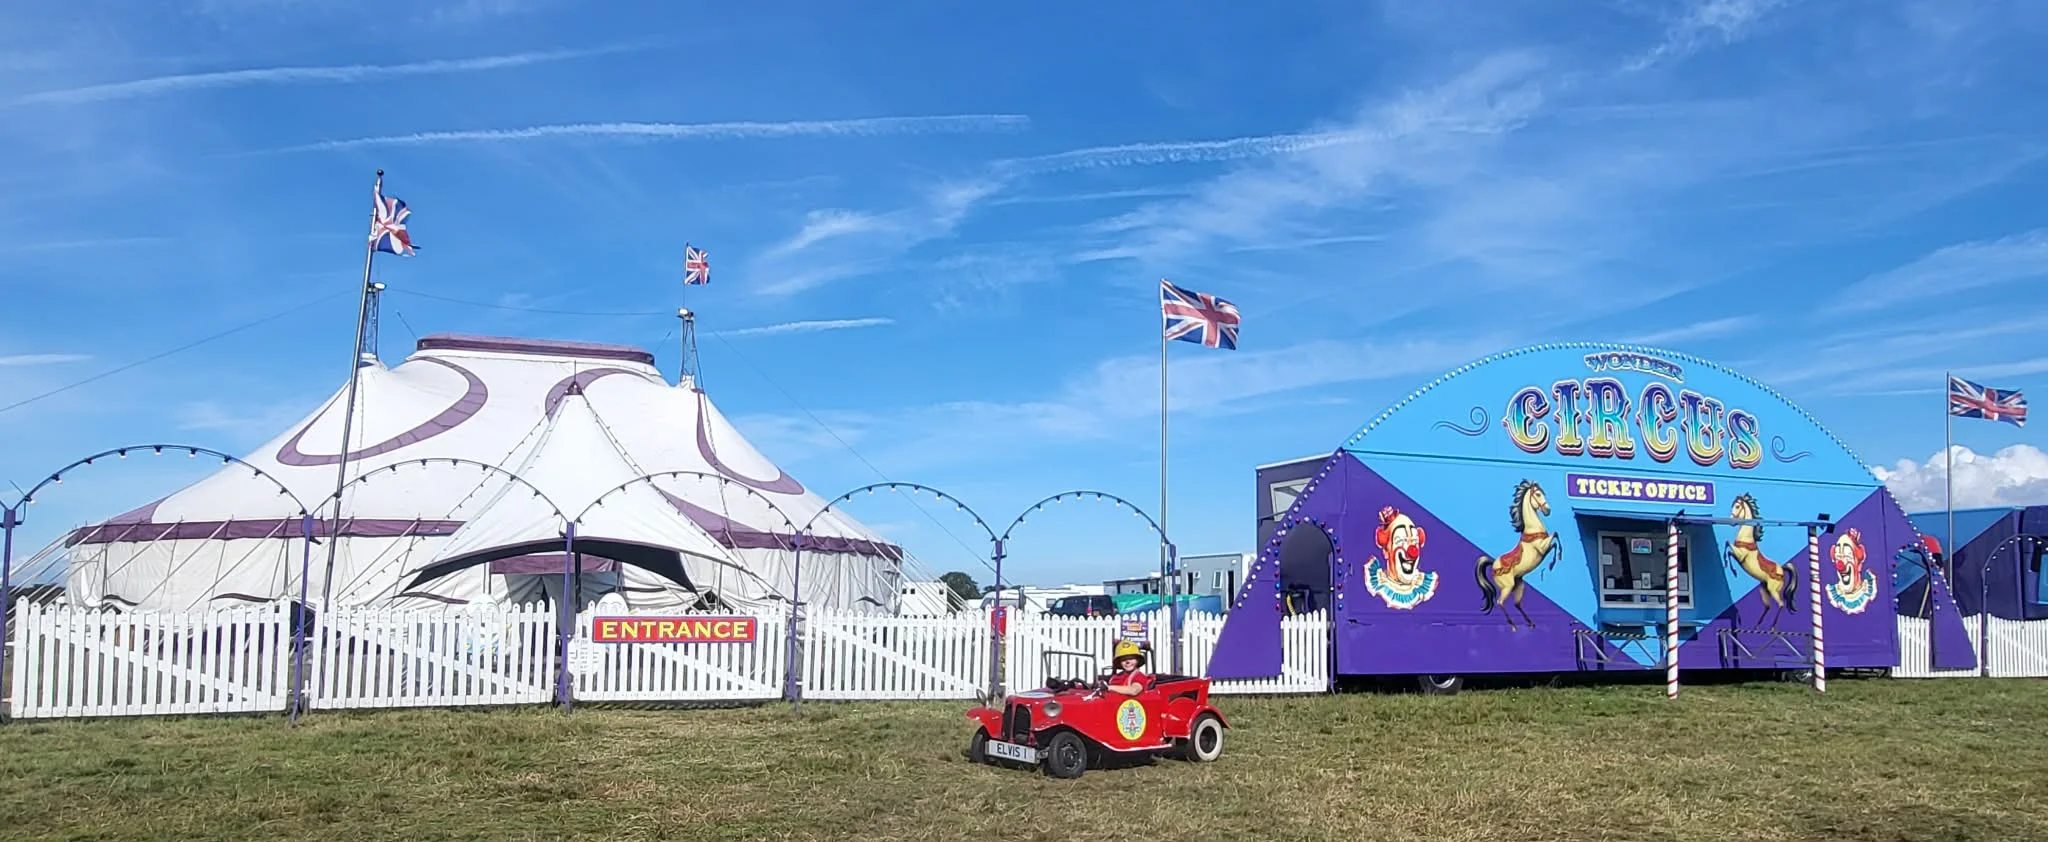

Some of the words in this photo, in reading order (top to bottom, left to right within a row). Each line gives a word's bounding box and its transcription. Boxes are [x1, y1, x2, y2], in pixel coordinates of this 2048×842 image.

[1584, 351, 1684, 383] WONDER
[1502, 377, 1763, 469] CIRCUS
[1577, 478, 1642, 497] TICKET
[1646, 482, 1706, 500] OFFICE
[602, 621, 748, 639] ENTRANCE
[997, 743, 1020, 757] ELVIS
